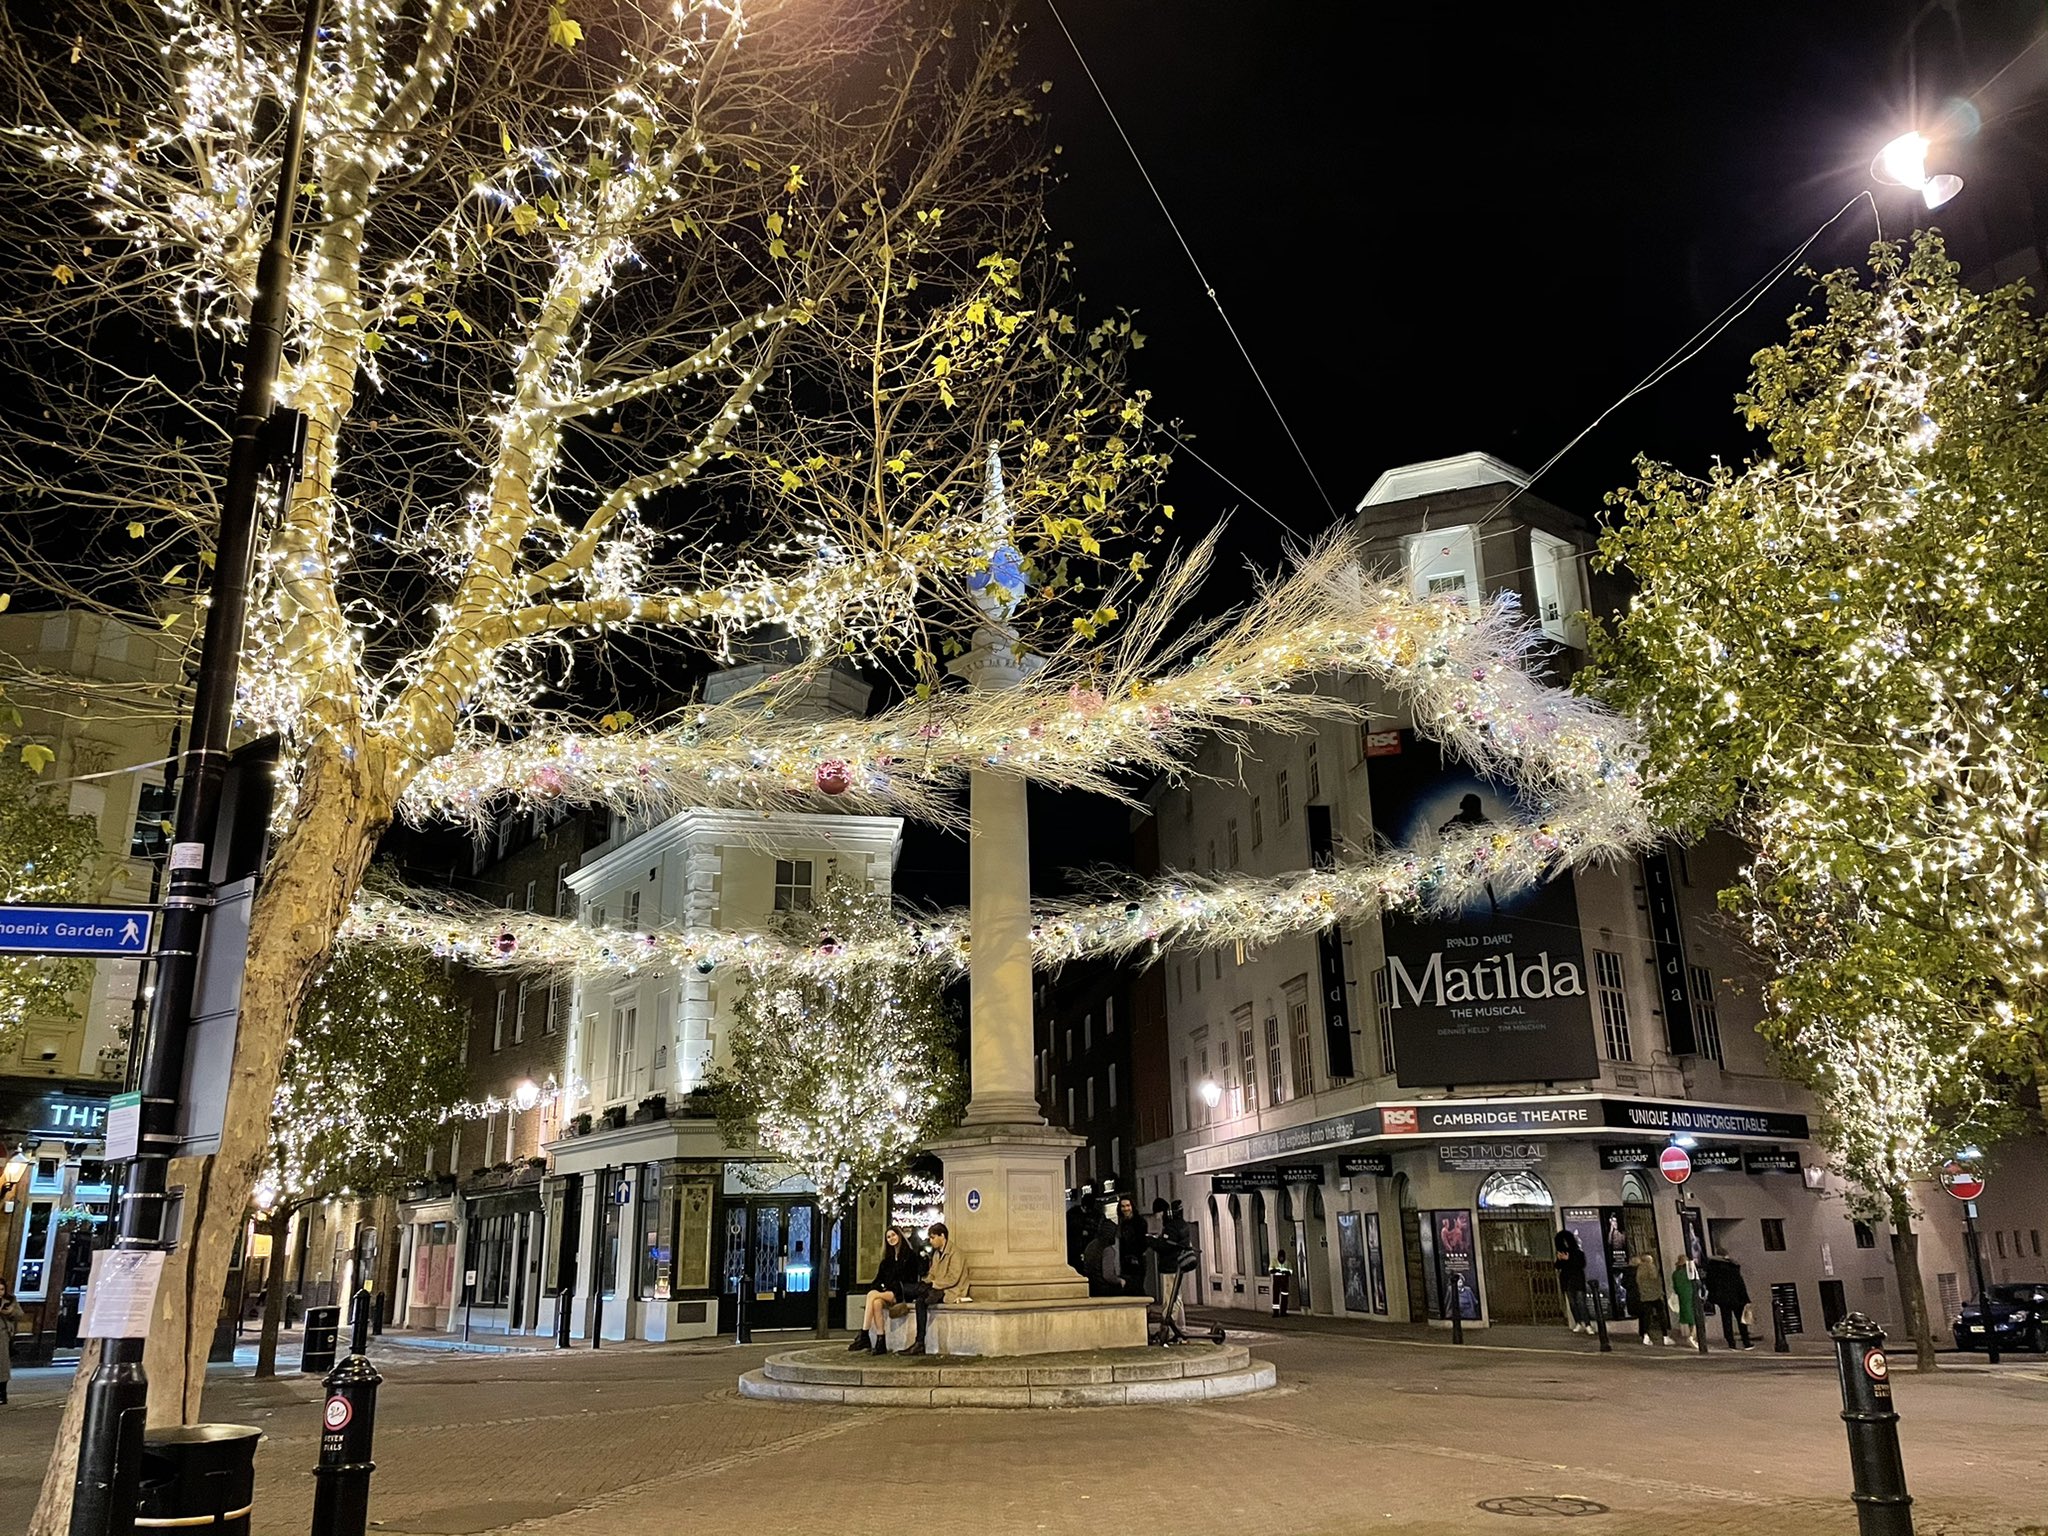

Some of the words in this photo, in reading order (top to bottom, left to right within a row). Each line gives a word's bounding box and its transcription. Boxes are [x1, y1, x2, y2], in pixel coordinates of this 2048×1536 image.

[0, 922, 49, 935] hoenix
[55, 923, 114, 937] Garden
[1446, 936, 1479, 948] ROALD
[1387, 951, 1585, 1009] Matilda
[1450, 1009, 1472, 1018] THE
[1475, 1005, 1526, 1017] MUSICAL
[51, 1104, 106, 1127] THE
[1383, 1110, 1415, 1125] RSC
[1433, 1111, 1517, 1126] CAMBRIDGE
[1521, 1109, 1588, 1122] THEATRE
[1629, 1109, 1668, 1126] 'UNIQUE
[1672, 1111, 1691, 1127] AND
[1693, 1114, 1768, 1133] UNFORGETTABLE'
[1325, 1126, 1335, 1140] the
[1440, 1145, 1475, 1159] BEST
[1481, 1144, 1547, 1159] MUSICAL
[1692, 1157, 1740, 1166] AZOR-SHARP'
